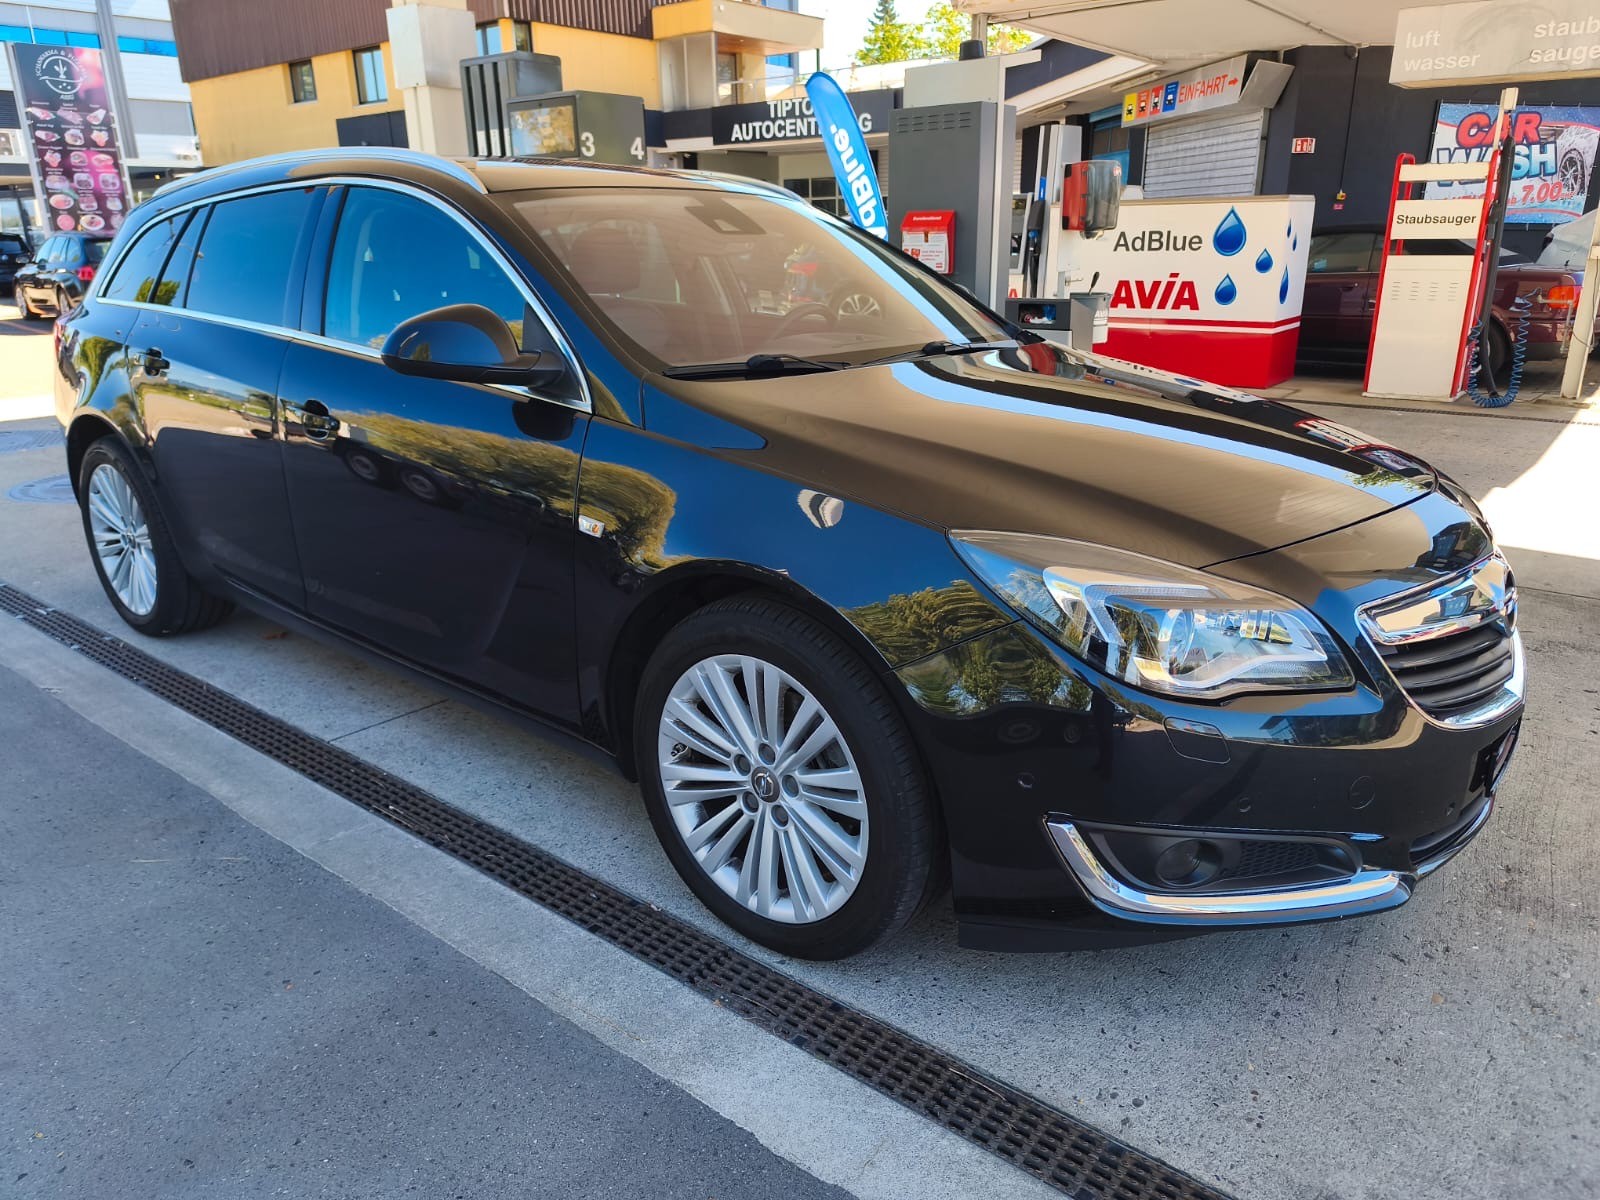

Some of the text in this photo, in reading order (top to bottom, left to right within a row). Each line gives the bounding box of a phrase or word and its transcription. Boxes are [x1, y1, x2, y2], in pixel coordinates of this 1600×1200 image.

[1406, 30, 1440, 49] luft
[1403, 54, 1481, 72] wasser
[1528, 44, 1600, 65] sauge
[1178, 73, 1229, 105] EINFAHRT
[767, 98, 815, 119] TIPTO
[731, 117, 823, 142] AUTOCENT
[1456, 110, 1542, 148] CAR
[580, 131, 596, 157] 3
[630, 137, 645, 160] 4
[1521, 181, 1564, 206] 7.00
[1395, 213, 1477, 227] Staubsauger
[1112, 229, 1204, 253] AdBlue
